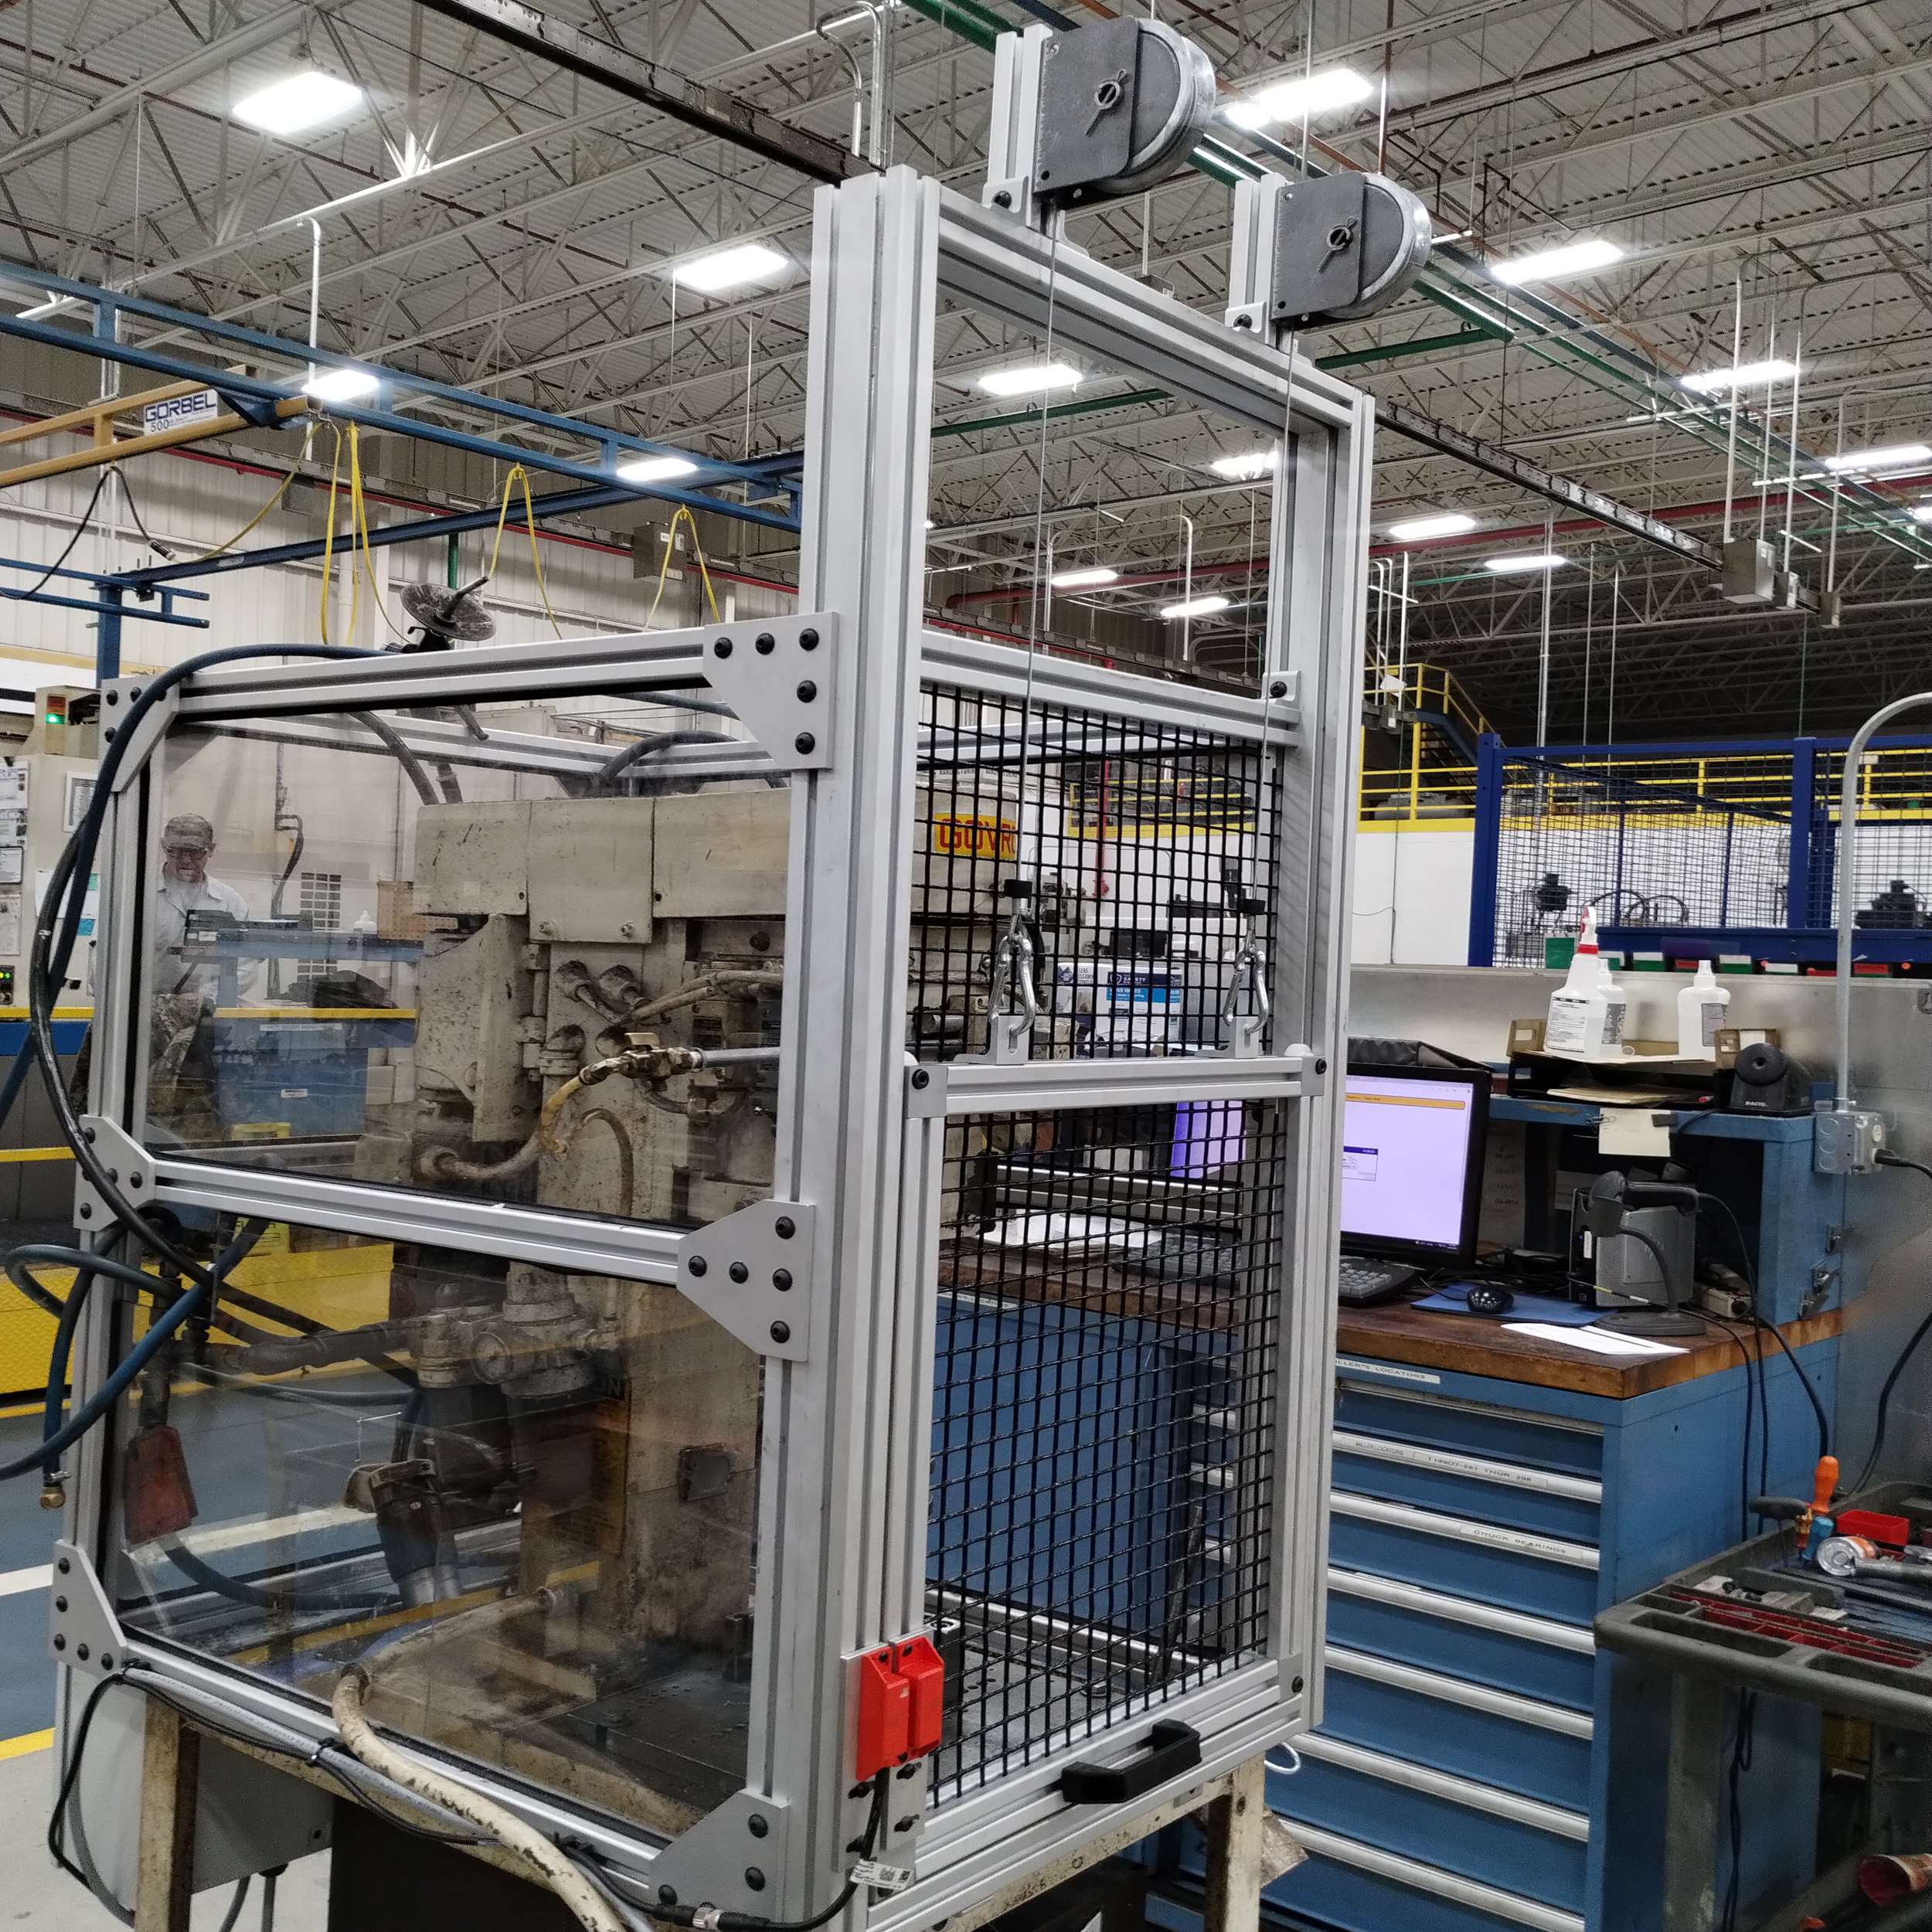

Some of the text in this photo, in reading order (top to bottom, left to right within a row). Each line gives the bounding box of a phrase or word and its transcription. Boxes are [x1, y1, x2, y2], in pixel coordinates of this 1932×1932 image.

[145, 393, 216, 422] GORBEL
[150, 420, 169, 432] 500
[1375, 1366, 1426, 1379] LOCATORS
[1355, 1440, 1403, 1456] MILLER LOCATORS
[1474, 1529, 1566, 1553] CHUCK BEARINGS
